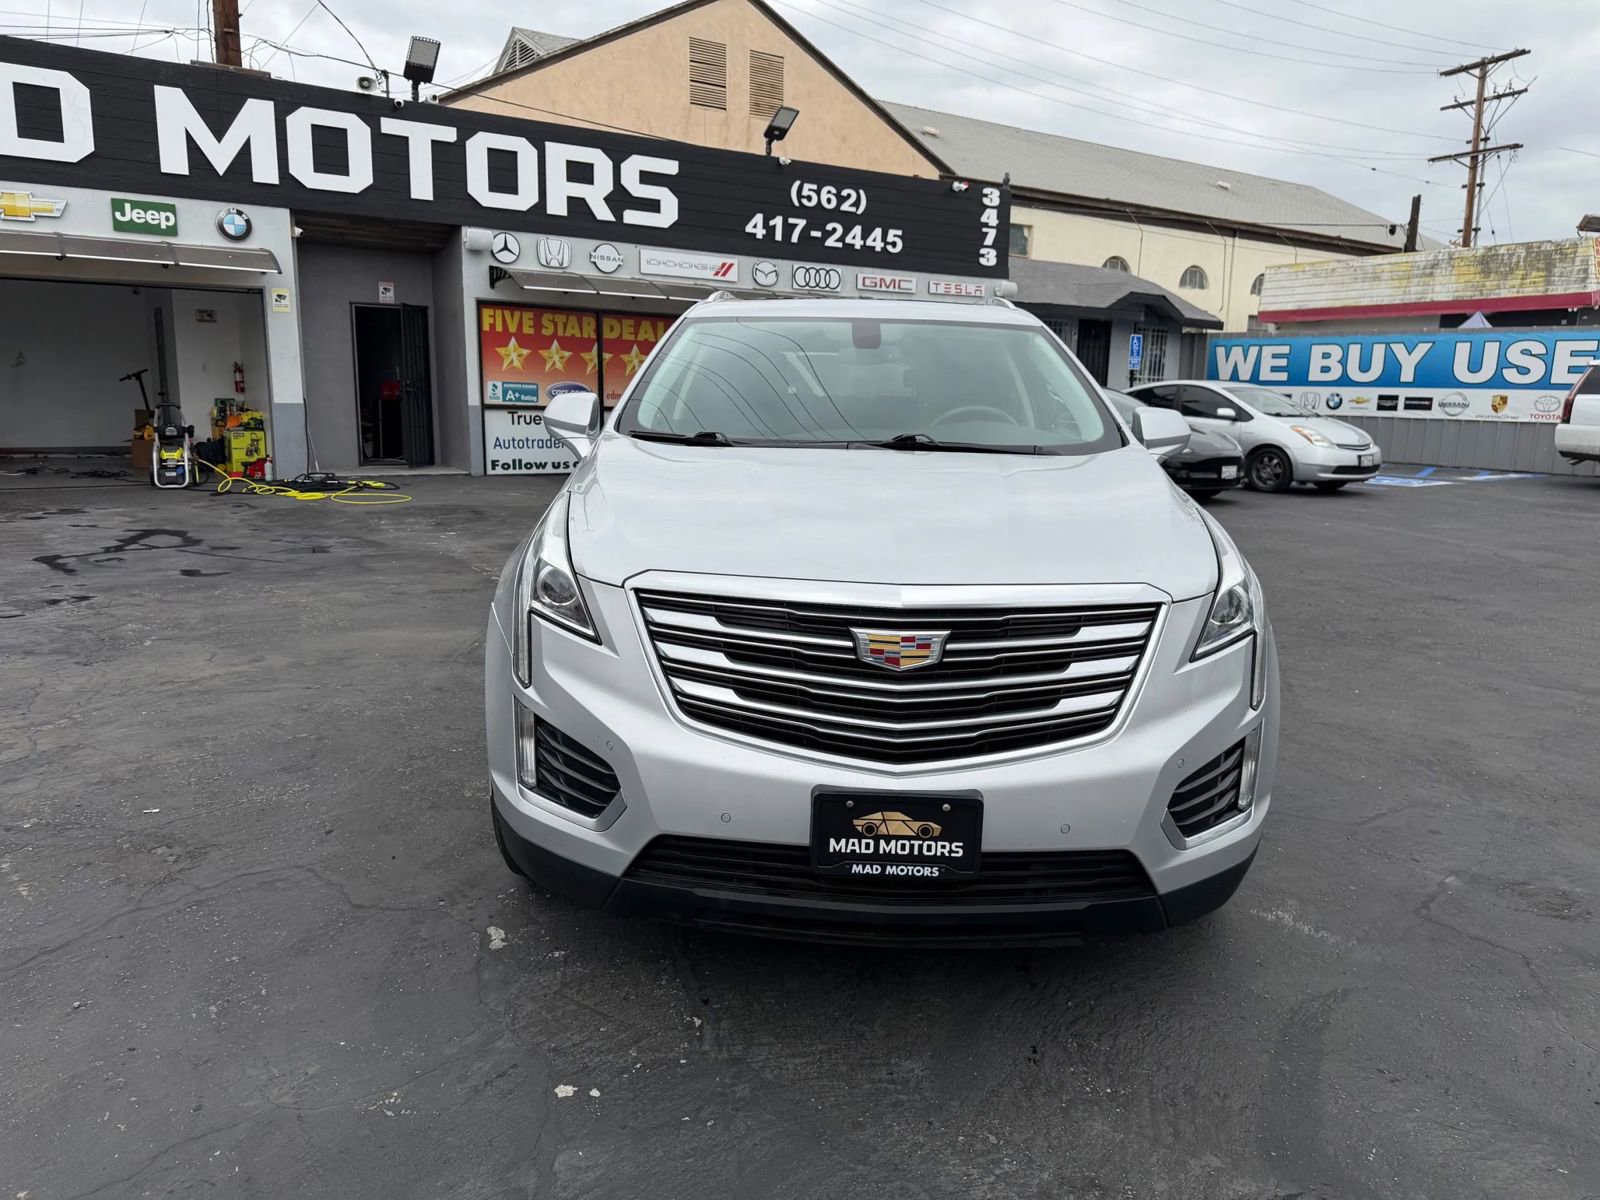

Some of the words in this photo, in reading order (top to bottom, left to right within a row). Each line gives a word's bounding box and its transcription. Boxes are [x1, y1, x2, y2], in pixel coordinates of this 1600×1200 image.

[153, 85, 679, 229] MOTORS
[790, 180, 867, 215] (562)
[114, 203, 176, 229] Jeep
[745, 213, 904, 254] 417-2445
[590, 253, 624, 263] NISSAN
[646, 258, 721, 272] DODGE
[862, 276, 913, 291] GMC
[932, 282, 983, 295] TESLA
[482, 308, 534, 334] FIVE
[541, 313, 597, 339] STAR
[1215, 344, 1292, 382] WE
[1307, 341, 1437, 384] BUY
[505, 389, 520, 401] A+
[507, 411, 543, 425] True
[491, 459, 548, 470] Follow
[551, 460, 570, 470] us
[829, 837, 874, 854] MAD
[879, 839, 963, 857] MOTORS
[851, 863, 882, 875] MAD
[885, 865, 940, 877] MOTORS
